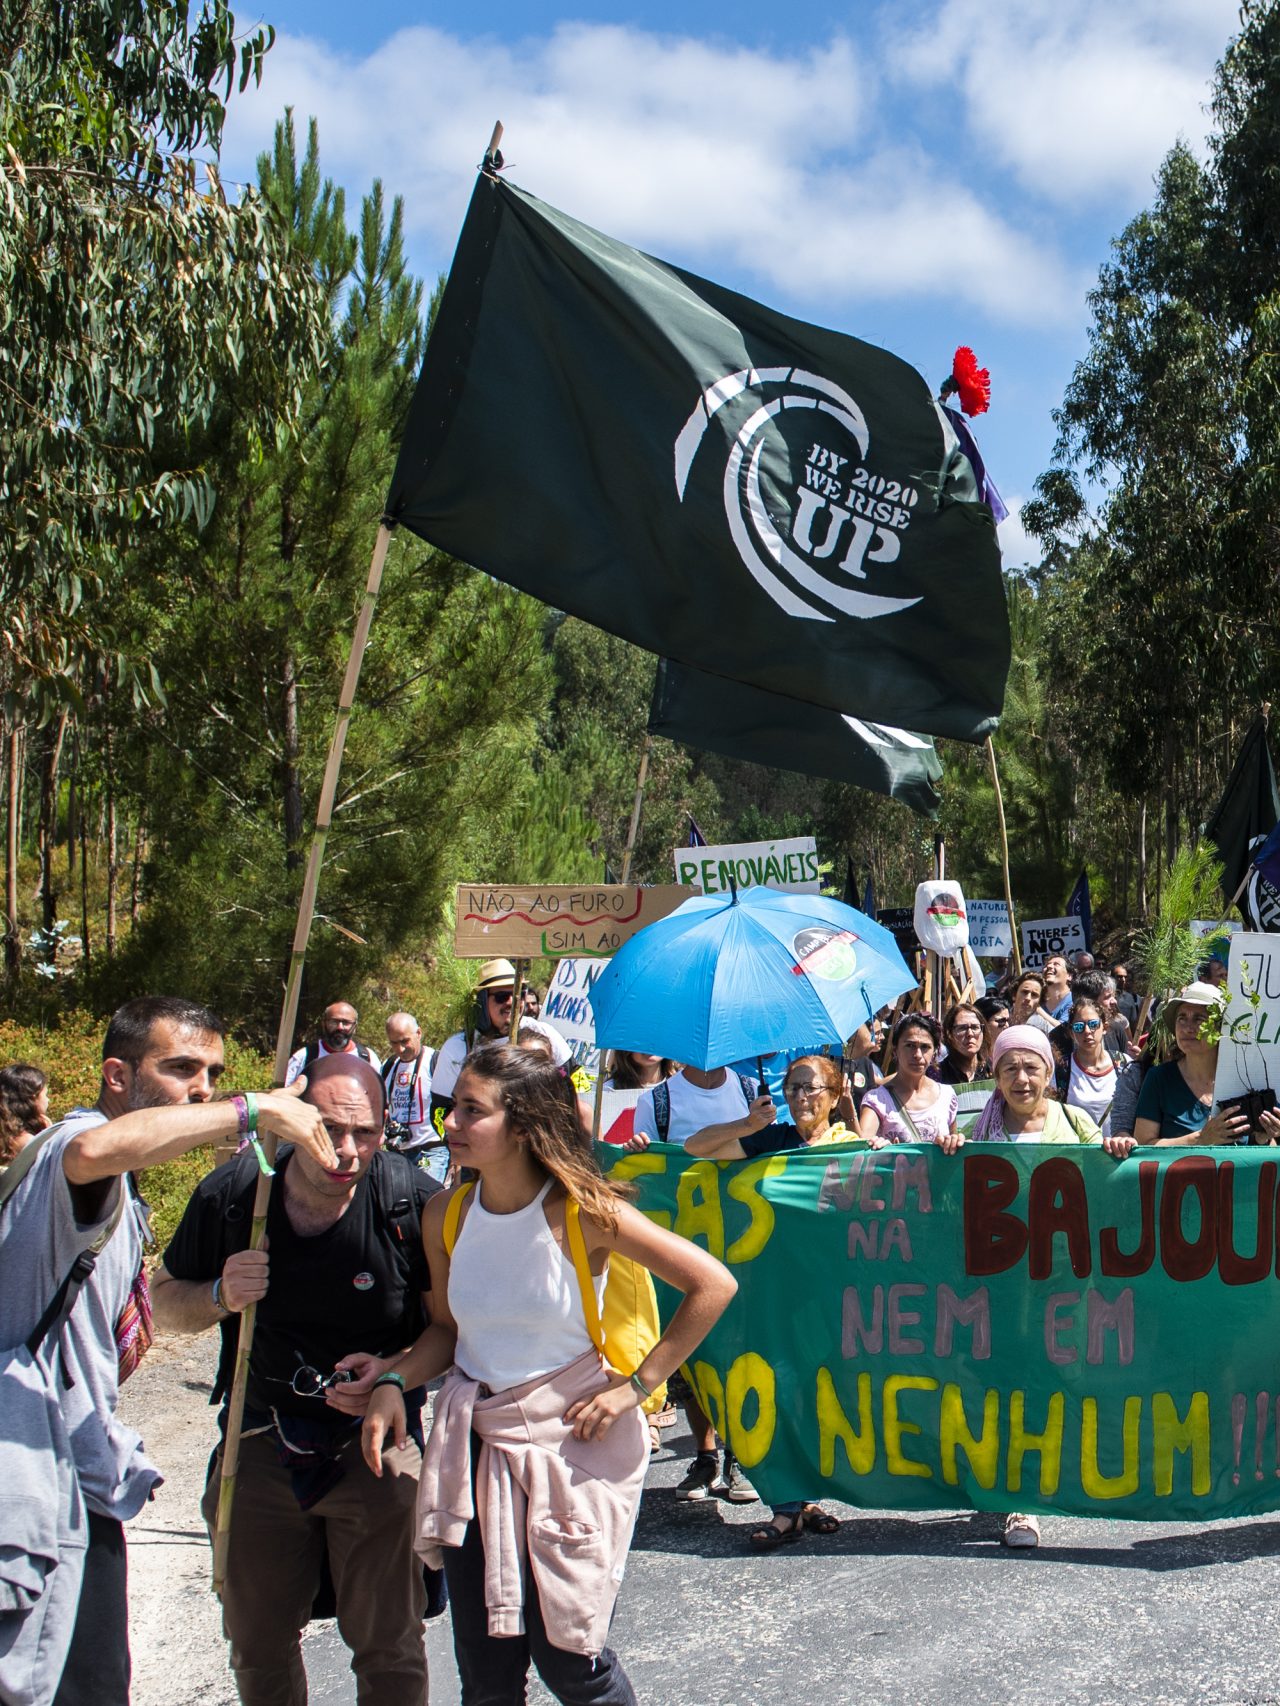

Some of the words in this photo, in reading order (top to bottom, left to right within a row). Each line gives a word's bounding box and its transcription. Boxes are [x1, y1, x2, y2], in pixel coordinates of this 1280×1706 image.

[805, 464, 842, 500] WE
[845, 488, 911, 530] RISE
[807, 443, 849, 475] BY
[851, 468, 919, 507] 2020
[792, 485, 901, 580] UP
[680, 845, 819, 894] RENOVÁVEIS
[469, 889, 514, 913] NÃO
[529, 894, 560, 913] AO
[570, 893, 625, 912] FURO
[970, 902, 1008, 911] NATUREZ
[549, 931, 586, 949] SIM
[597, 934, 621, 949] AO
[1027, 924, 1081, 941] THERE'S
[1029, 937, 1065, 954] NO
[558, 959, 577, 988] OS
[817, 1151, 933, 1213] NEM
[847, 1217, 913, 1261] NA
[840, 1282, 993, 1361] NEM
[1043, 1286, 1136, 1367] EM
